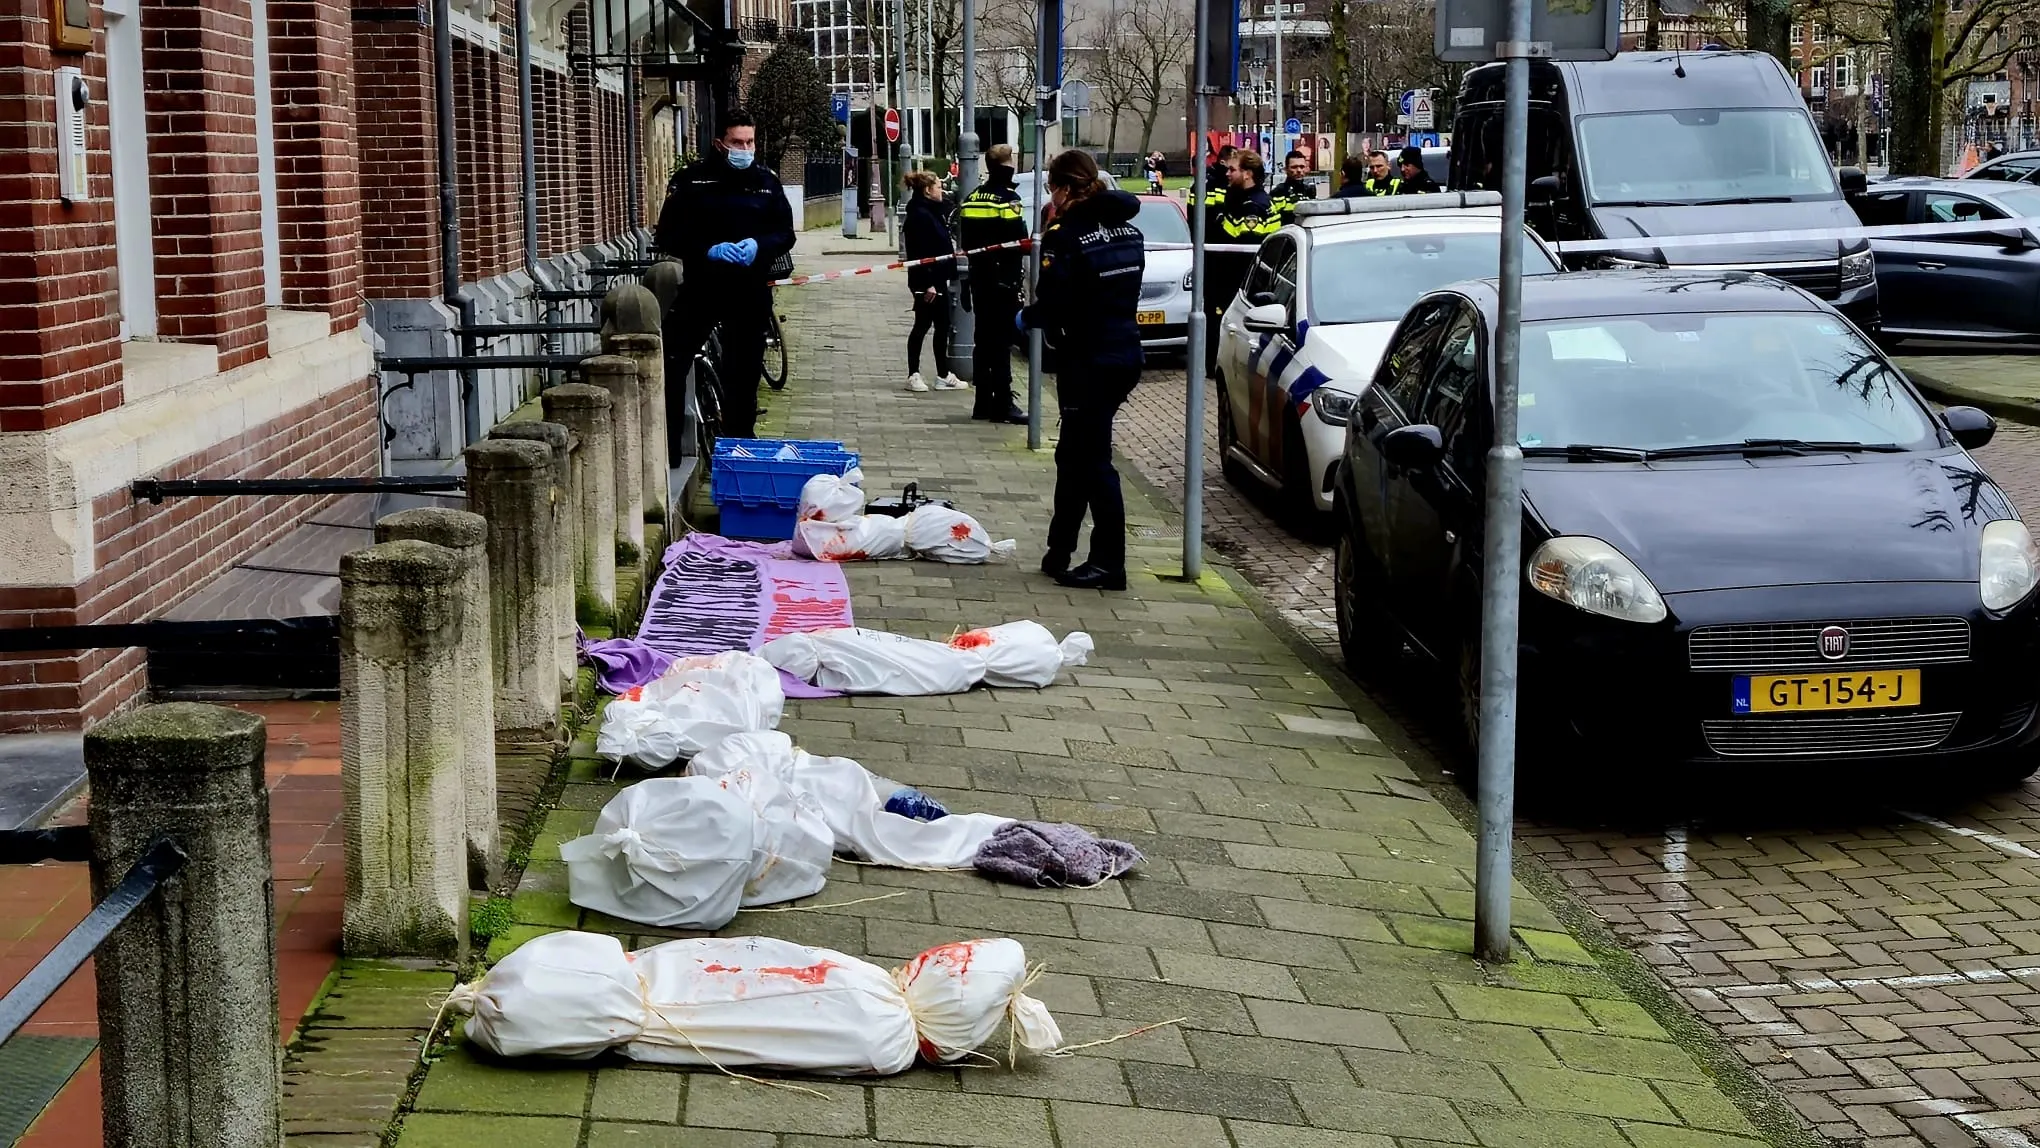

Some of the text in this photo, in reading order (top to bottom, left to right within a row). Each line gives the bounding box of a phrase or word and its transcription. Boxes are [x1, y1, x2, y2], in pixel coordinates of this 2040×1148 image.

[836, 101, 843, 111] P
[1137, 313, 1162, 323] 0-PP
[1824, 636, 1844, 652] FIAT
[1735, 675, 1903, 707] NL GT-154-J
